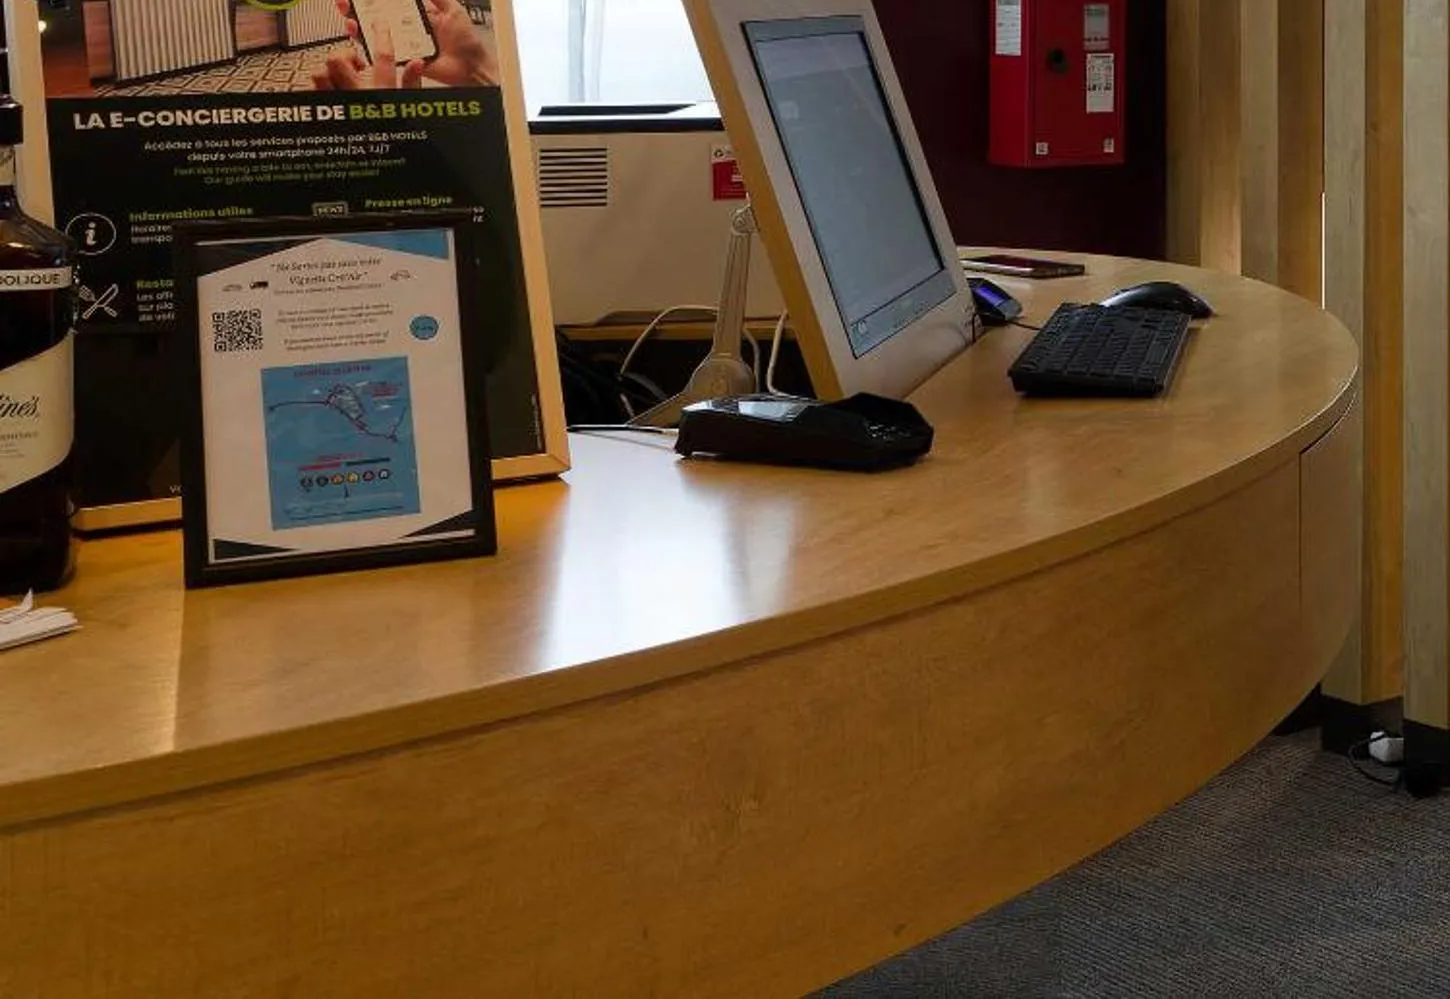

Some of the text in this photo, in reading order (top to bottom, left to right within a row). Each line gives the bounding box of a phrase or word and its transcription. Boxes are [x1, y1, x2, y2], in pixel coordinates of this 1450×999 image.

[73, 101, 481, 130] LA E-CONCIERGERIE DE B&B HOTELS
[204, 138, 230, 148] tous
[231, 137, 248, 147] les
[129, 207, 253, 221] Informations utiles
[131, 224, 172, 234] Horaire
